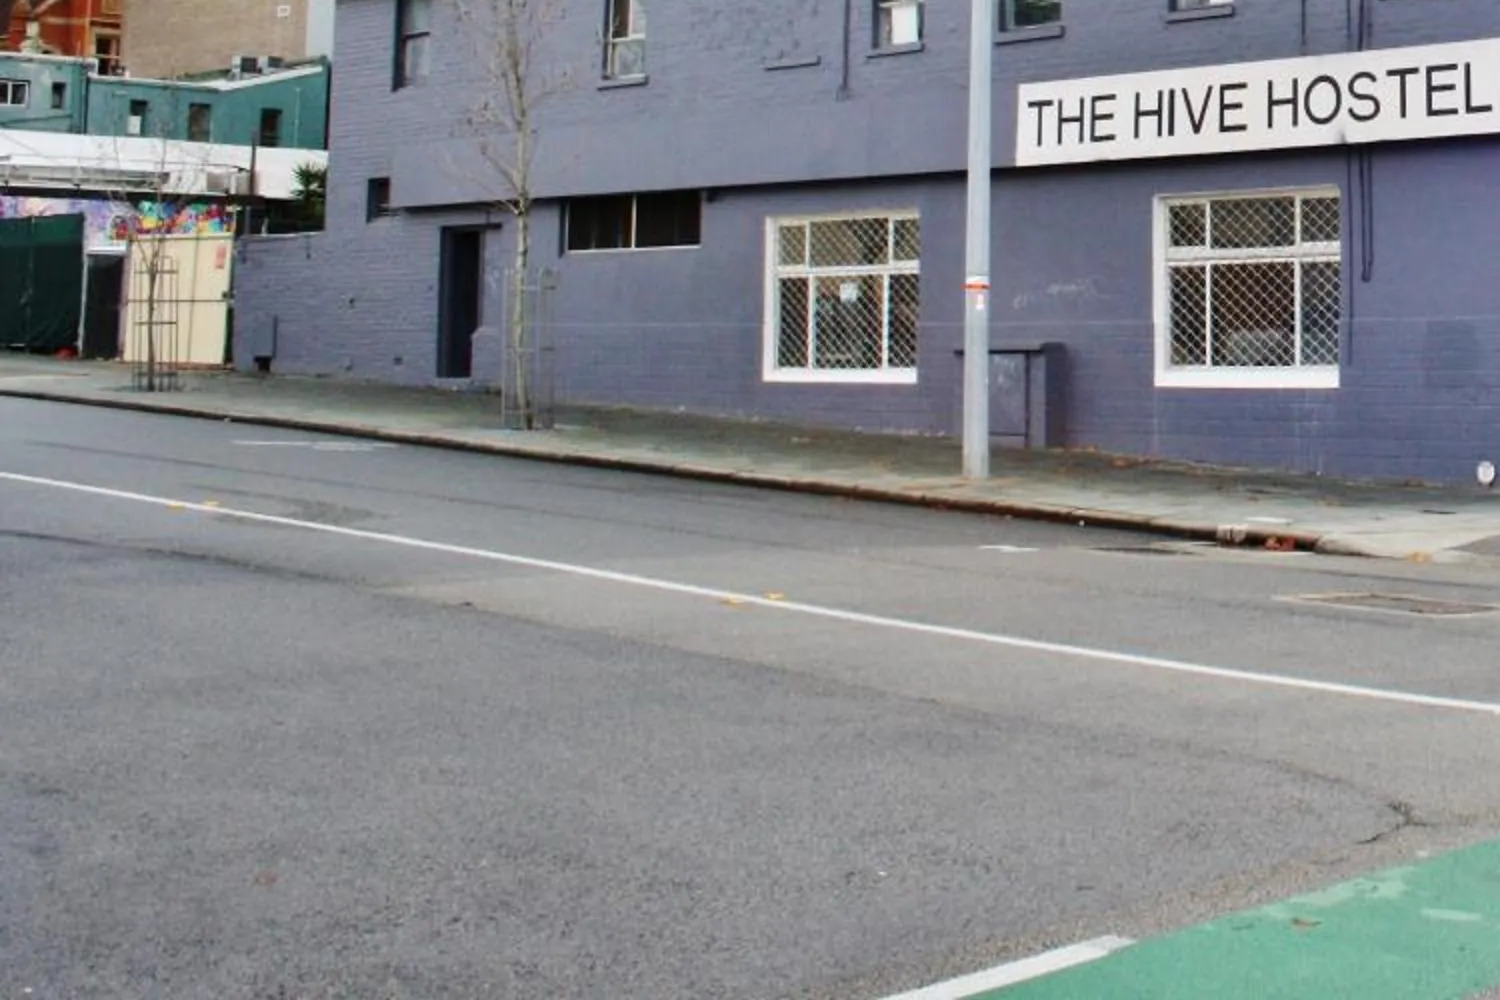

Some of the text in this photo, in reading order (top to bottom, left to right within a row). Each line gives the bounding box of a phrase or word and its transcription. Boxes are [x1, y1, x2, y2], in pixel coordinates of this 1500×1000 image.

[1027, 61, 1493, 147] THE HIVE HOSTEL
